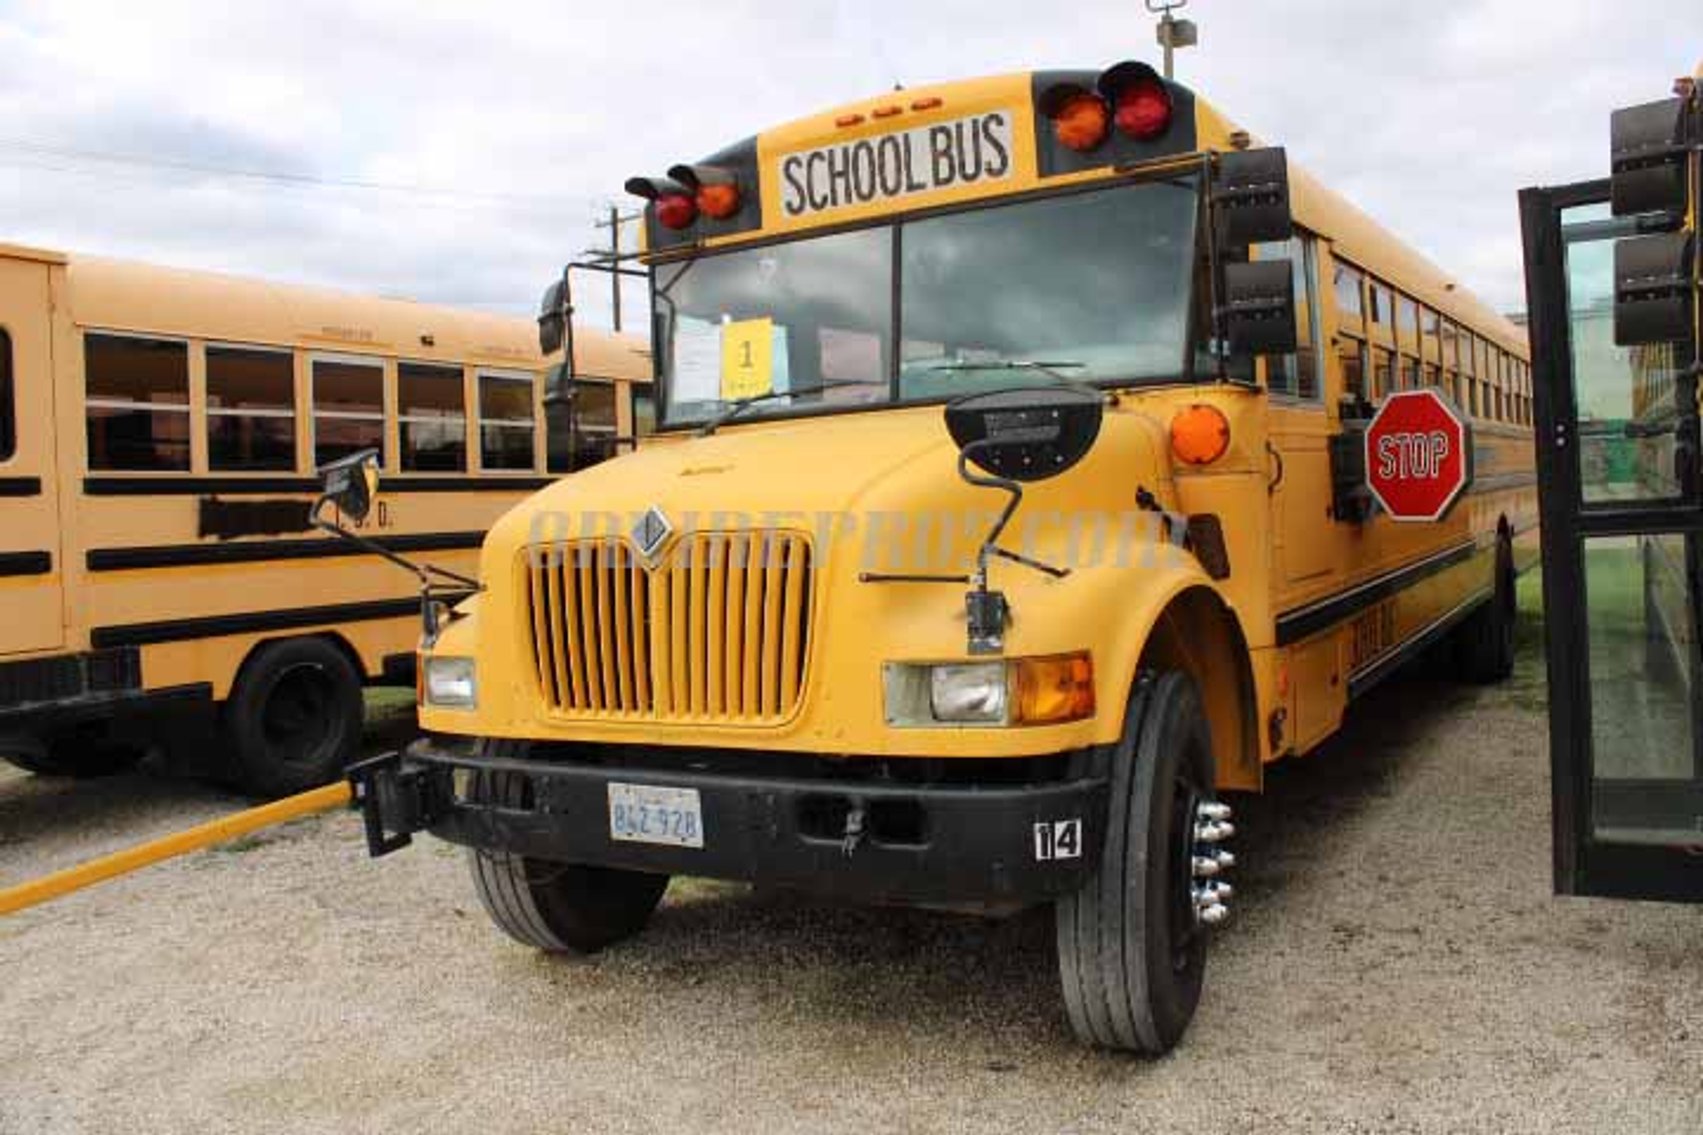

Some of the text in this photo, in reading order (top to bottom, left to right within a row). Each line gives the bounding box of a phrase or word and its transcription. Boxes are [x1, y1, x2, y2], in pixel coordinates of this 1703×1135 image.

[783, 113, 1009, 215] SCHOOL BUS
[739, 340, 754, 368] 1
[1378, 430, 1449, 479] STOP
[1038, 822, 1077, 857] 14
